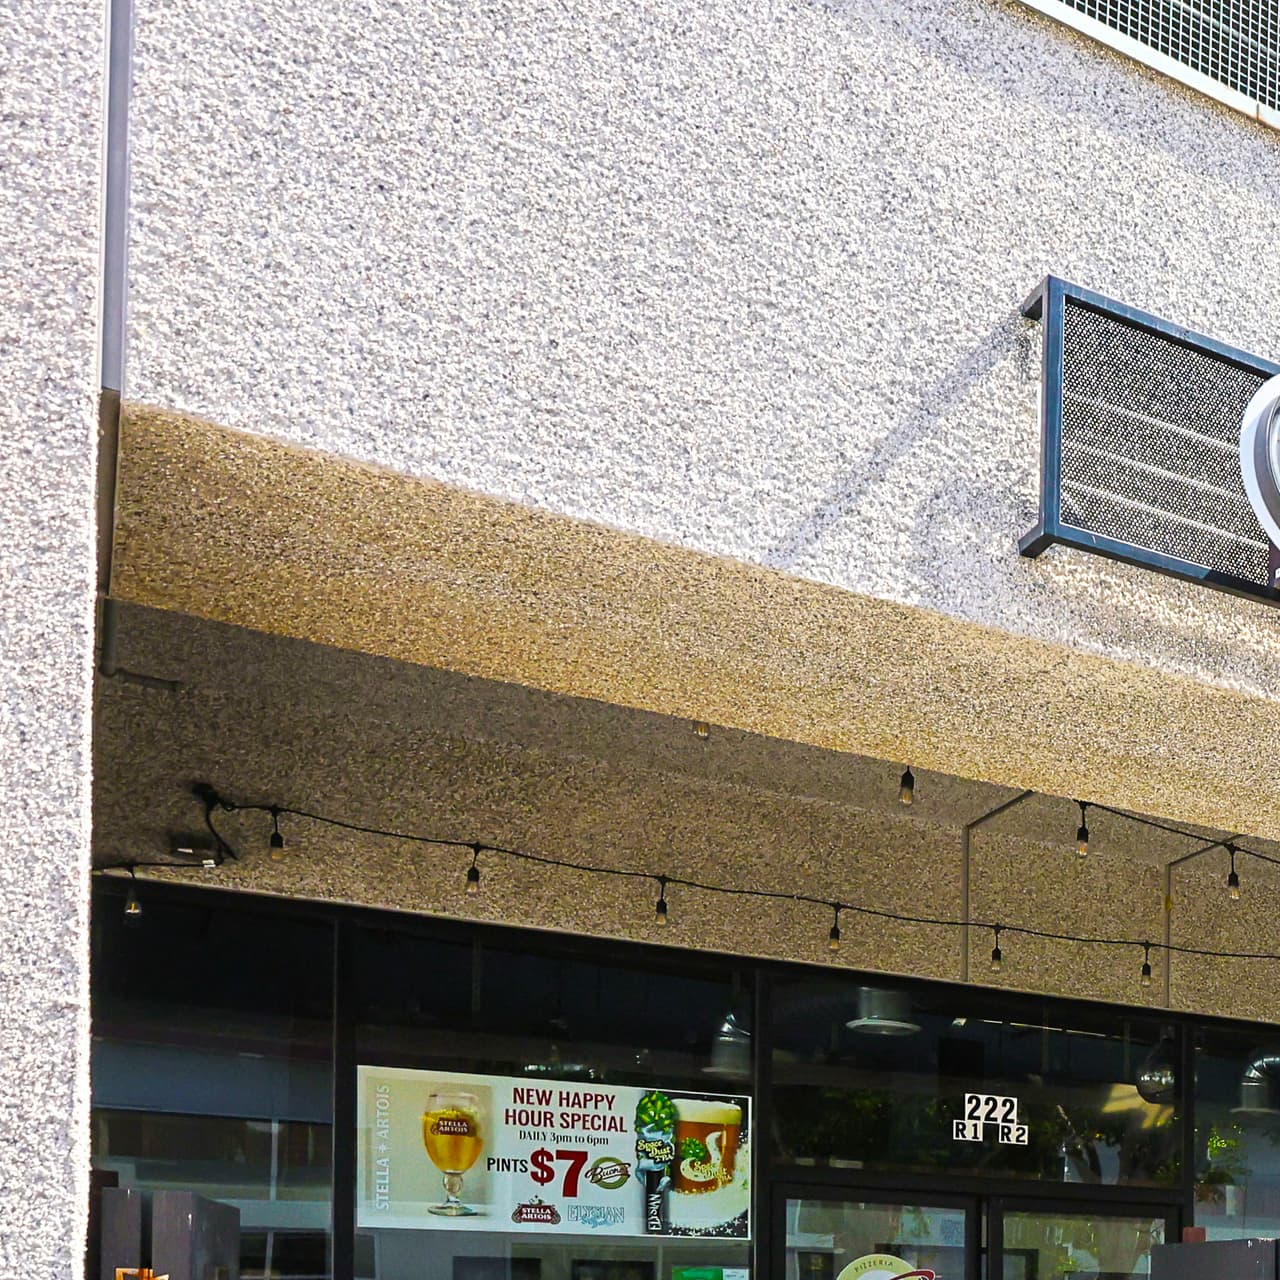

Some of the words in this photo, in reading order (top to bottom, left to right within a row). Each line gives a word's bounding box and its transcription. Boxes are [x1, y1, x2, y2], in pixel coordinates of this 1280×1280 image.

[376, 1085, 390, 1139] ARTOIS
[513, 1088, 553, 1106] NEW
[559, 1091, 616, 1111] HAPPY
[967, 1095, 1015, 1123] 222
[505, 1108, 555, 1128] HOUR
[559, 1112, 628, 1133] SPECIAL
[519, 1130, 548, 1141] DAILY
[550, 1132, 572, 1145] 3pm
[574, 1135, 585, 1144] to
[587, 1136, 609, 1147] 6pm
[375, 1158, 390, 1210] STELLA
[487, 1157, 528, 1173] PINTS
[530, 1147, 588, 1198] $7
[854, 1259, 894, 1273] PIZZERIA
